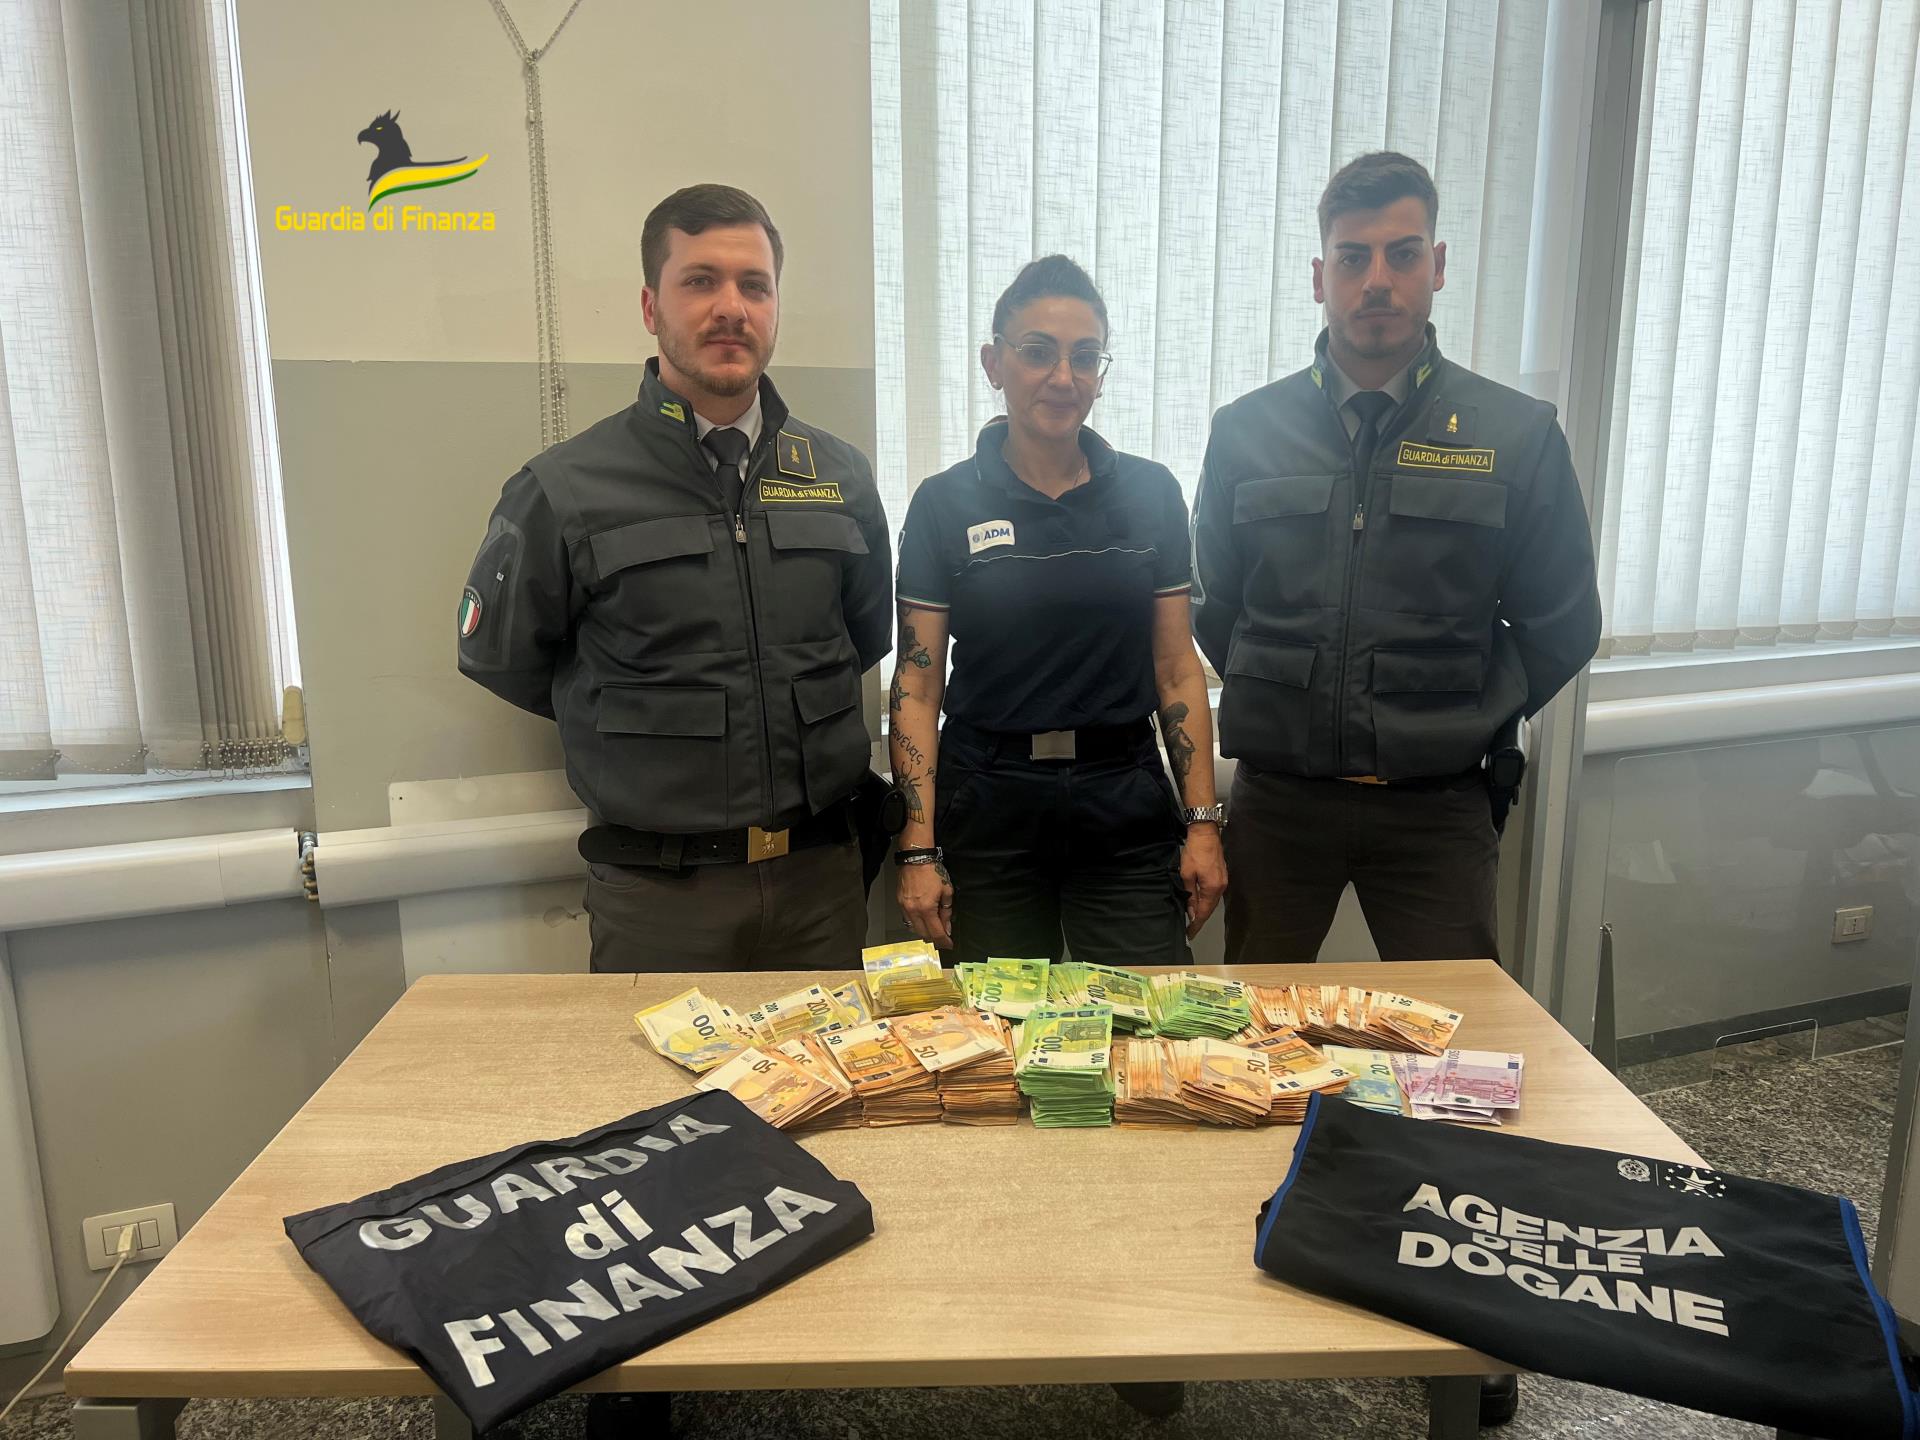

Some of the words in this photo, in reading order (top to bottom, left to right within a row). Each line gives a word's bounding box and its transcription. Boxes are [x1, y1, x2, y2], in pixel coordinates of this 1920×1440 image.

[1402, 449, 1440, 463] GUARDIA
[1441, 455, 1450, 464] di
[1450, 455, 1488, 466] FINANZA
[763, 486, 798, 498] GUARDIA
[797, 489, 805, 499] di
[805, 489, 838, 498] FINANZA
[984, 528, 1010, 541] ADM
[465, 592, 480, 609] ITALIA
[984, 982, 1003, 1003] 100
[1086, 984, 1107, 1001] 100
[806, 998, 832, 1016] 200
[827, 1035, 843, 1045] 50
[874, 1036, 899, 1051] 50
[1039, 1036, 1064, 1054] 100
[914, 1045, 939, 1059] 50
[1090, 1052, 1105, 1064] 100
[751, 1059, 778, 1074] 50
[1247, 1059, 1267, 1075] 50
[1370, 1063, 1391, 1076] 20
[358, 1113, 732, 1251] GUARDIA
[564, 1190, 654, 1260] di
[1402, 1183, 1725, 1257] AGENZIA
[1472, 1232, 1644, 1275] DELLE
[443, 1186, 838, 1388] FINANZA
[1398, 1231, 1730, 1337] DOGANE
